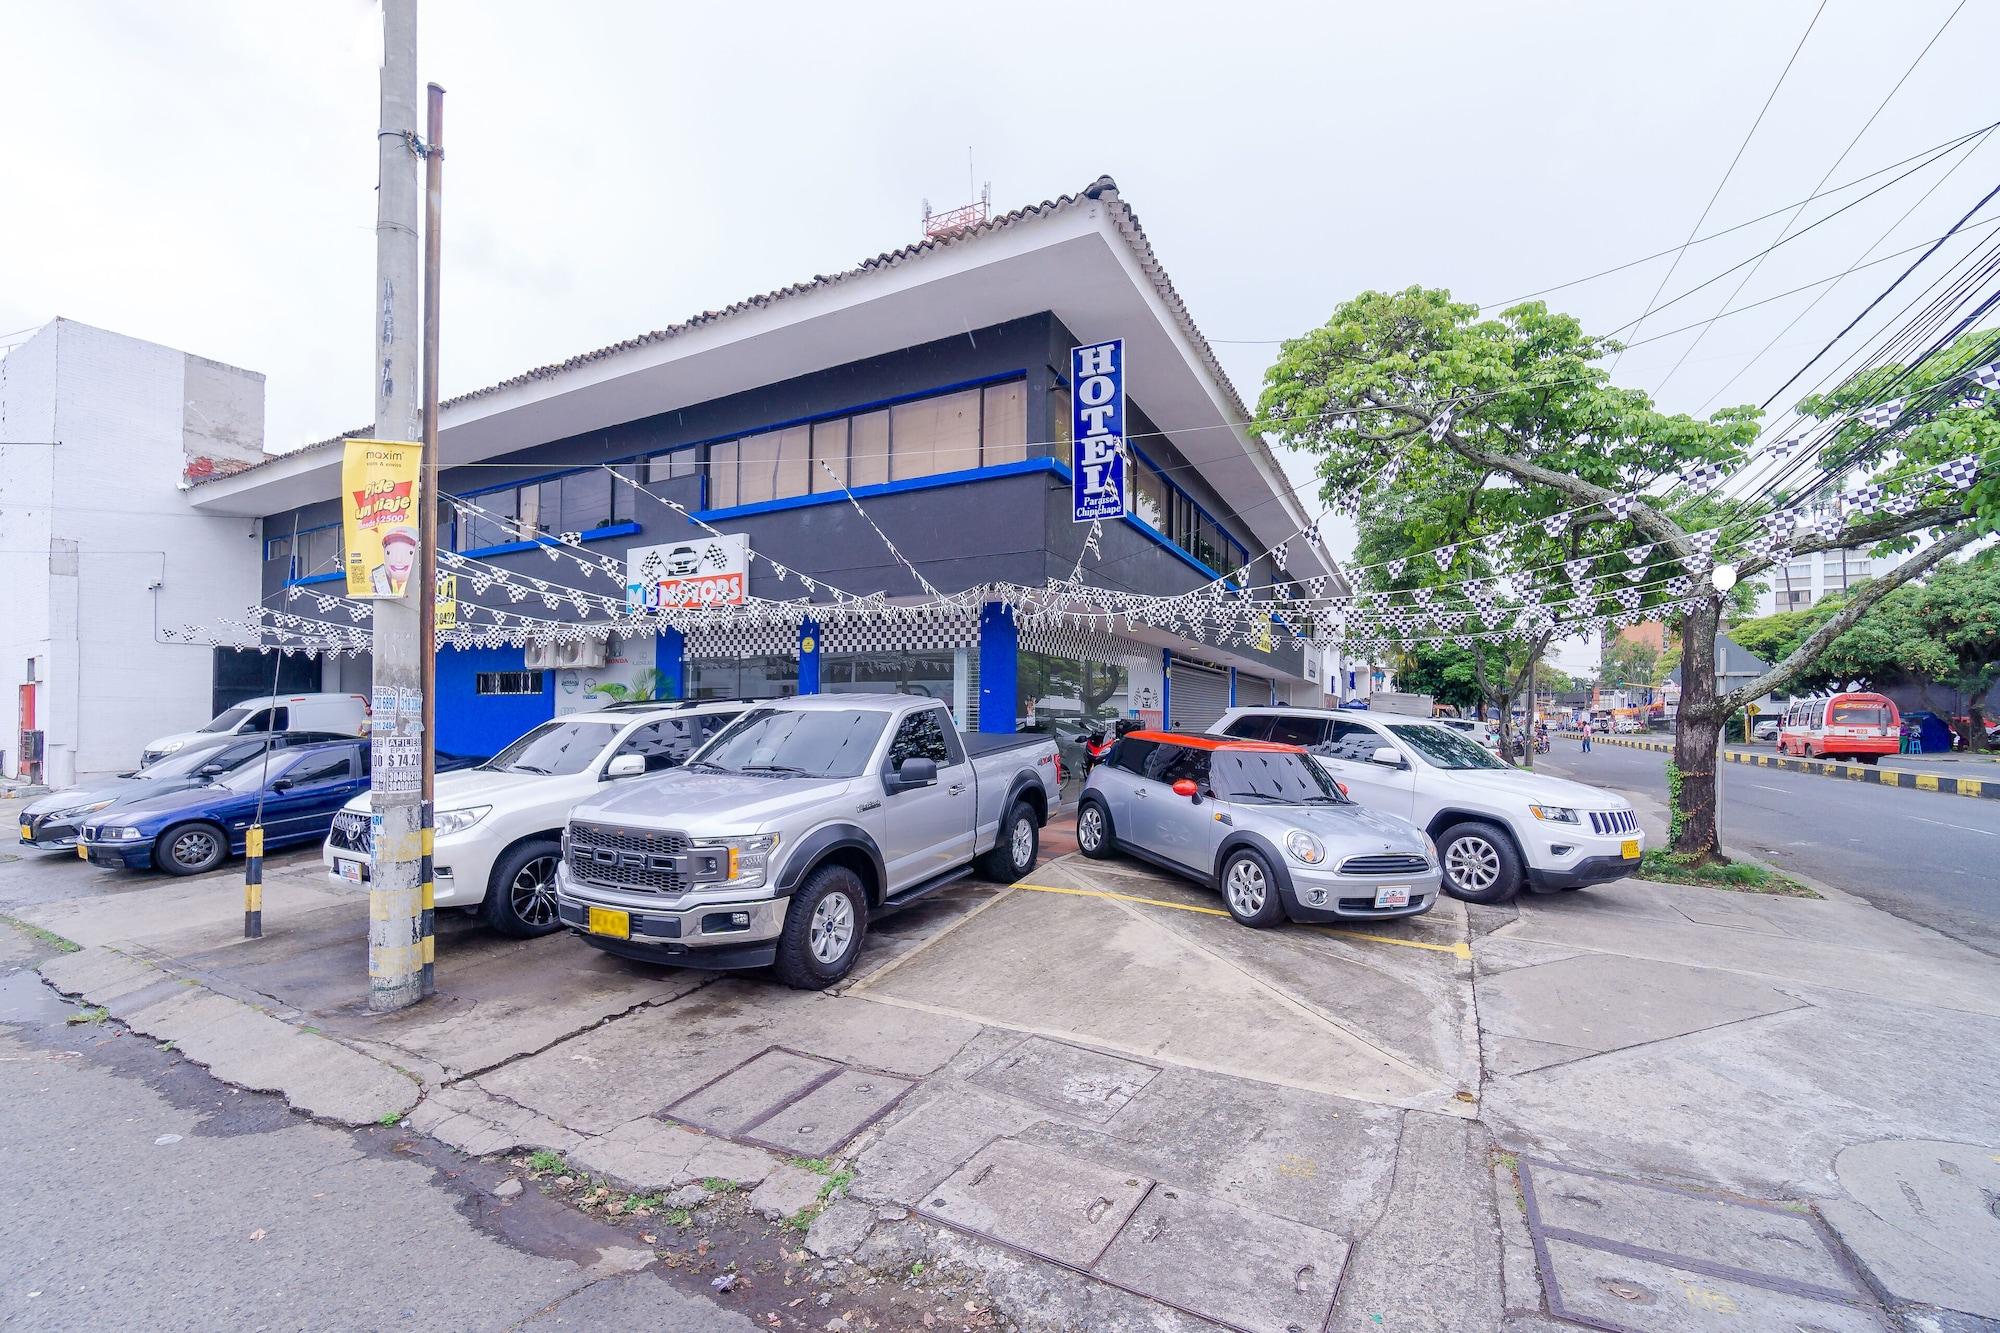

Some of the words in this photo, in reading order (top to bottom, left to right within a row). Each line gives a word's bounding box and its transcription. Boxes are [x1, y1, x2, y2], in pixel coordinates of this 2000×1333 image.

[1079, 345, 1115, 495] HOTEL
[366, 450, 402, 460] maxim
[1076, 504, 1122, 518] Chipichape
[660, 577, 740, 607] MOTORS
